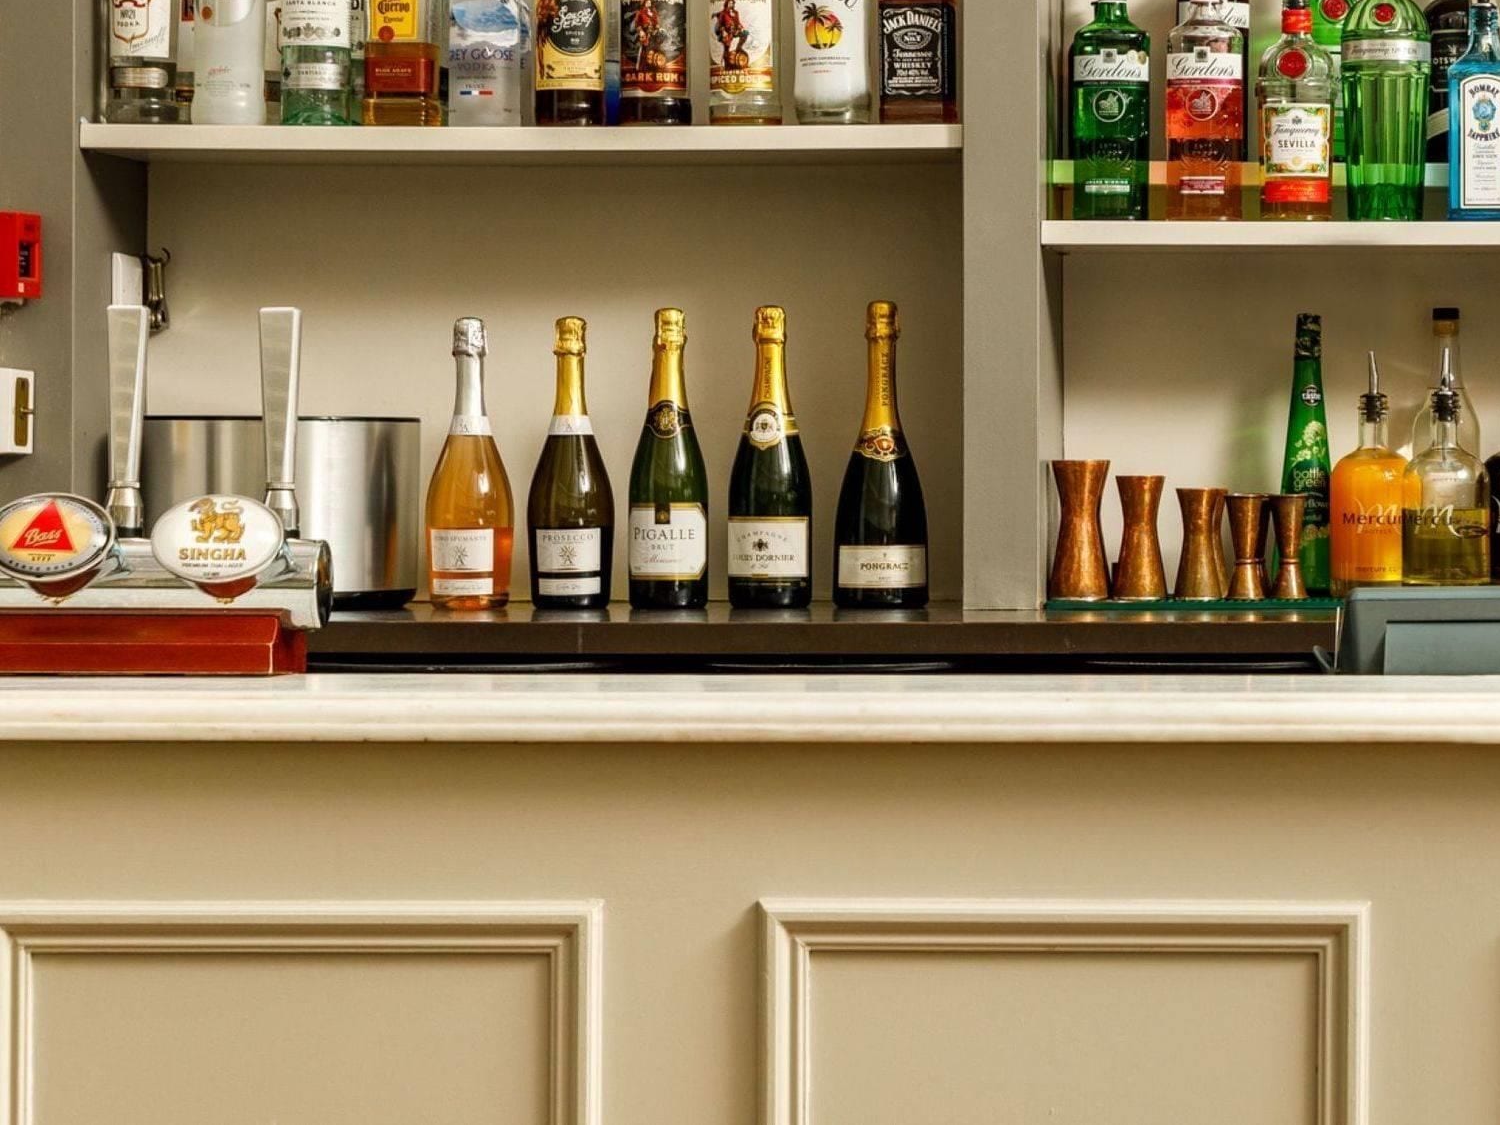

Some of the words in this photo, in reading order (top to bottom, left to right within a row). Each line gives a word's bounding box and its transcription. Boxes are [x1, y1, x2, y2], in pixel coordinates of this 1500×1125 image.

[378, 0, 410, 15] Cuervo
[883, 14, 906, 34] JACK
[450, 48, 468, 61] REY
[471, 48, 513, 62] GOOSE
[457, 62, 497, 72] VODKA
[1080, 57, 1142, 78] Gordon's
[1172, 57, 1235, 78] Gordon's
[656, 72, 679, 83] RUM
[1468, 84, 1500, 99] BOMBAY
[1273, 124, 1320, 138] Tanqueray
[1467, 129, 1500, 142] SAPPHIRE
[1278, 139, 1316, 149] SEVILLA
[1342, 512, 1401, 526] Mercu
[24, 527, 63, 546] Bass
[542, 533, 594, 543] PROSECCO
[633, 526, 696, 540] PIGALLE
[736, 530, 789, 543] CHAMPAGNE
[179, 547, 247, 561] SINGHA
[651, 543, 676, 551] BRUT
[755, 554, 796, 562] DORNIER
[860, 561, 909, 571] PONGRACZ
